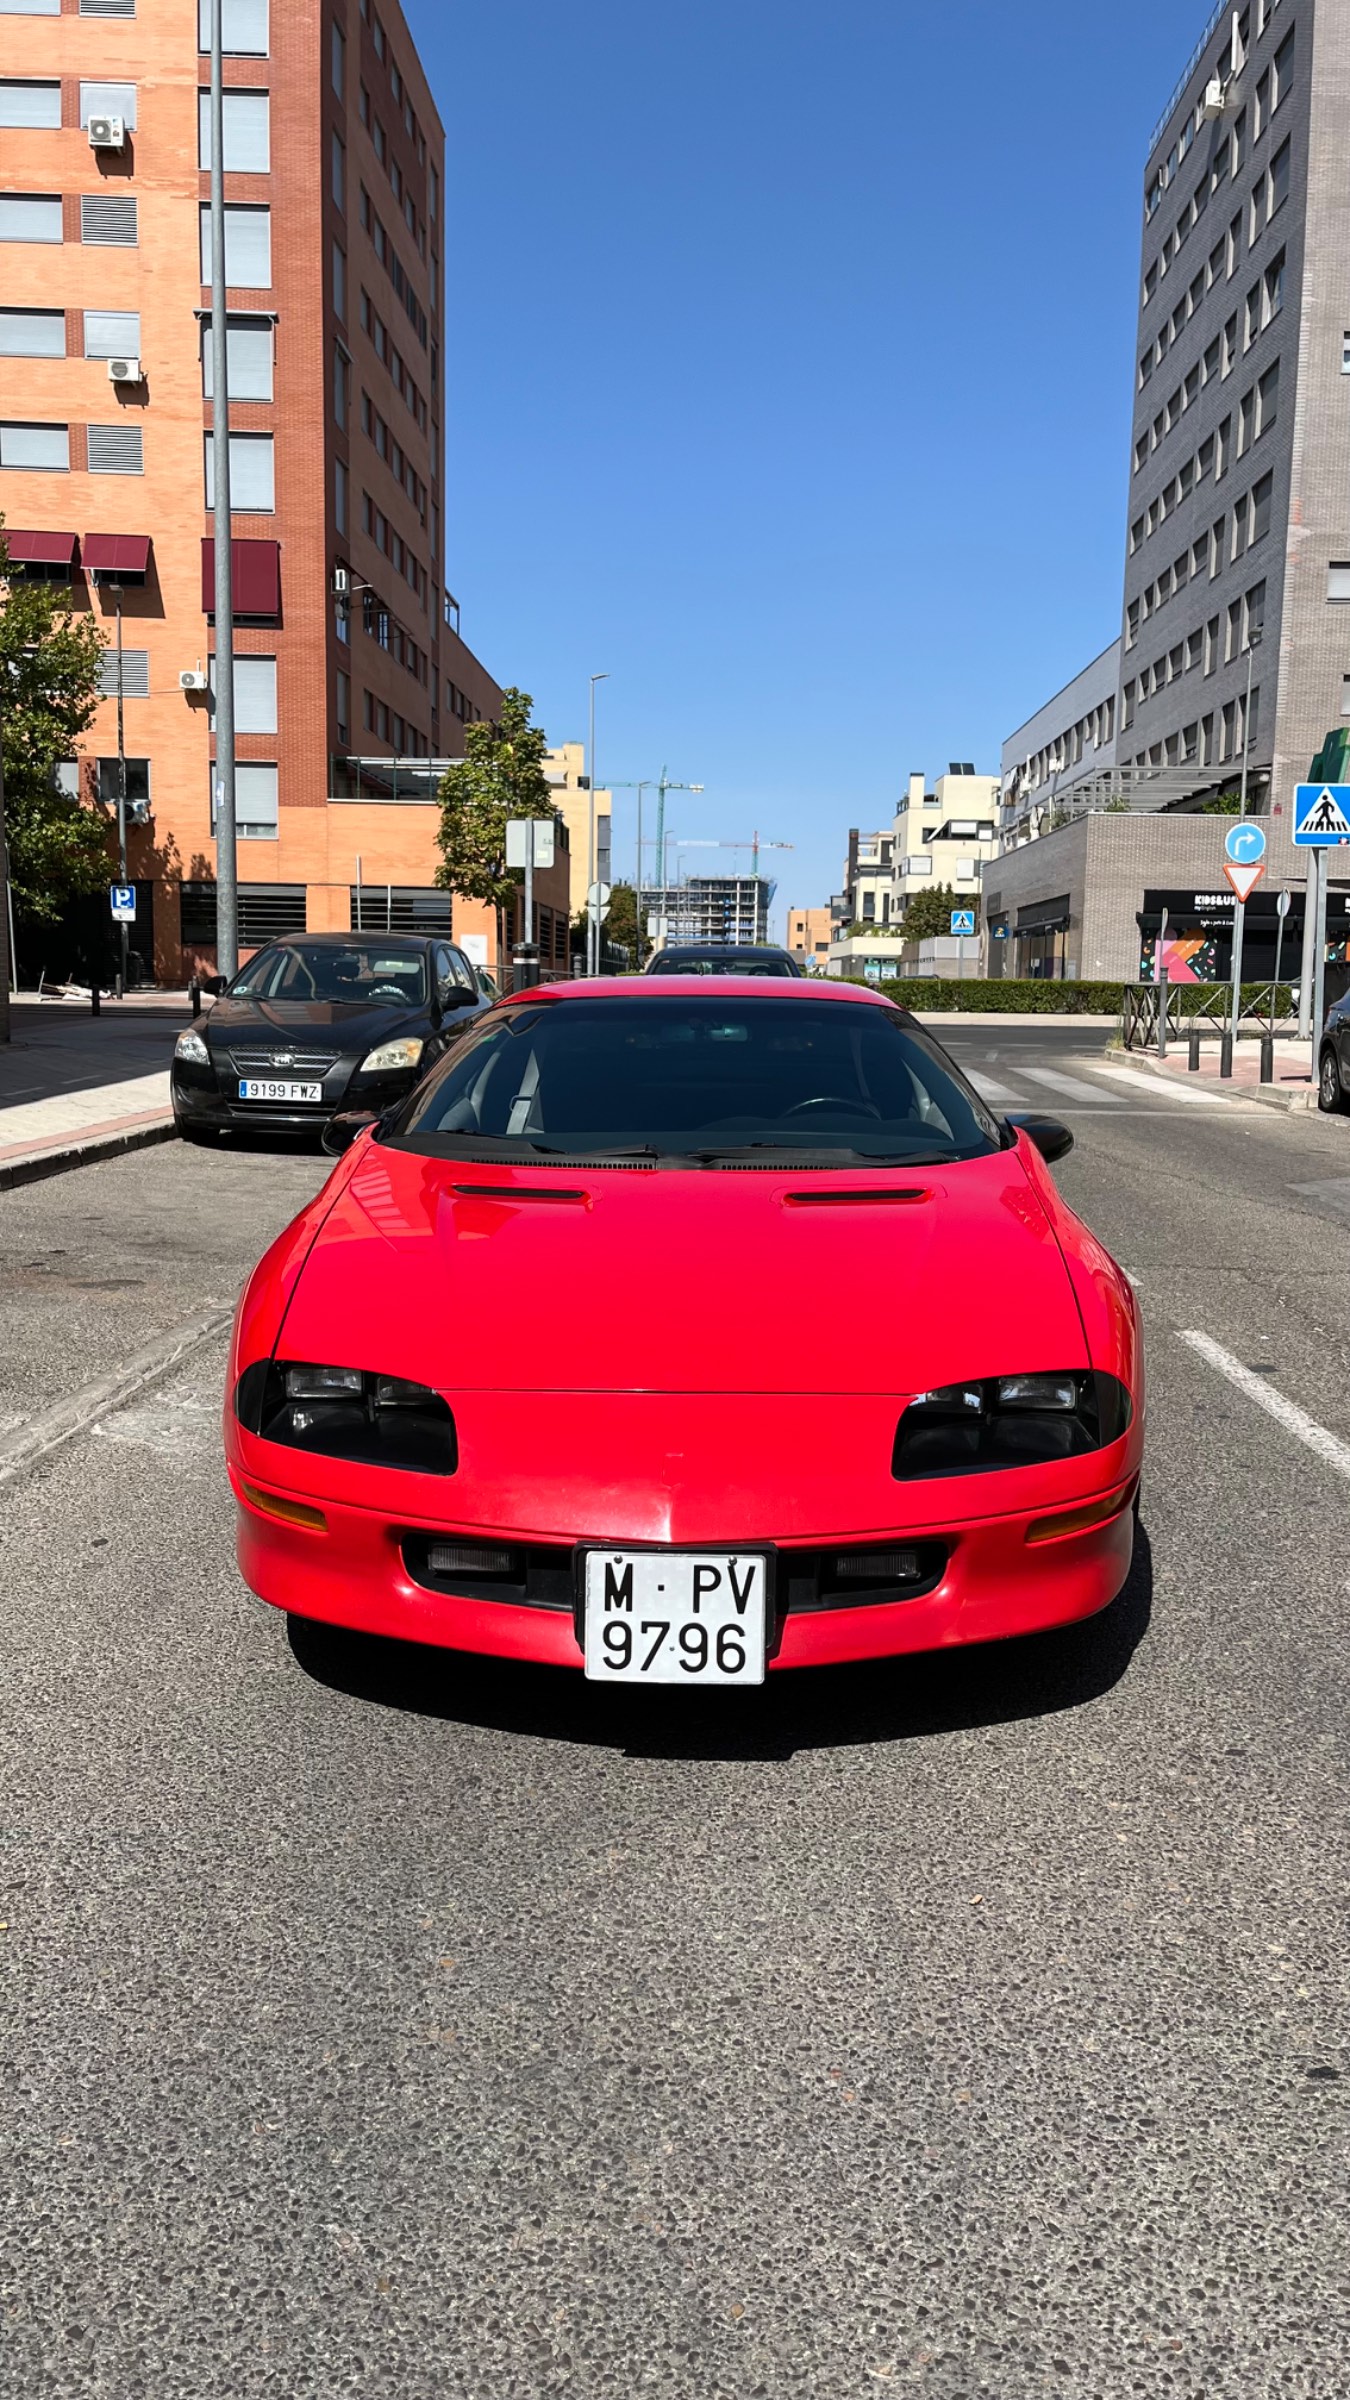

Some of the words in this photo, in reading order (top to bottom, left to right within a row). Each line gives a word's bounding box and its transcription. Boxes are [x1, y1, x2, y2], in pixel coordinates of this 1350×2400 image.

[116, 888, 131, 907] P
[250, 1083, 286, 1098] 9199
[291, 1085, 318, 1099] FWZ
[604, 1562, 633, 1612] M
[692, 1564, 756, 1615] PV
[602, 1620, 746, 1674] 9796
